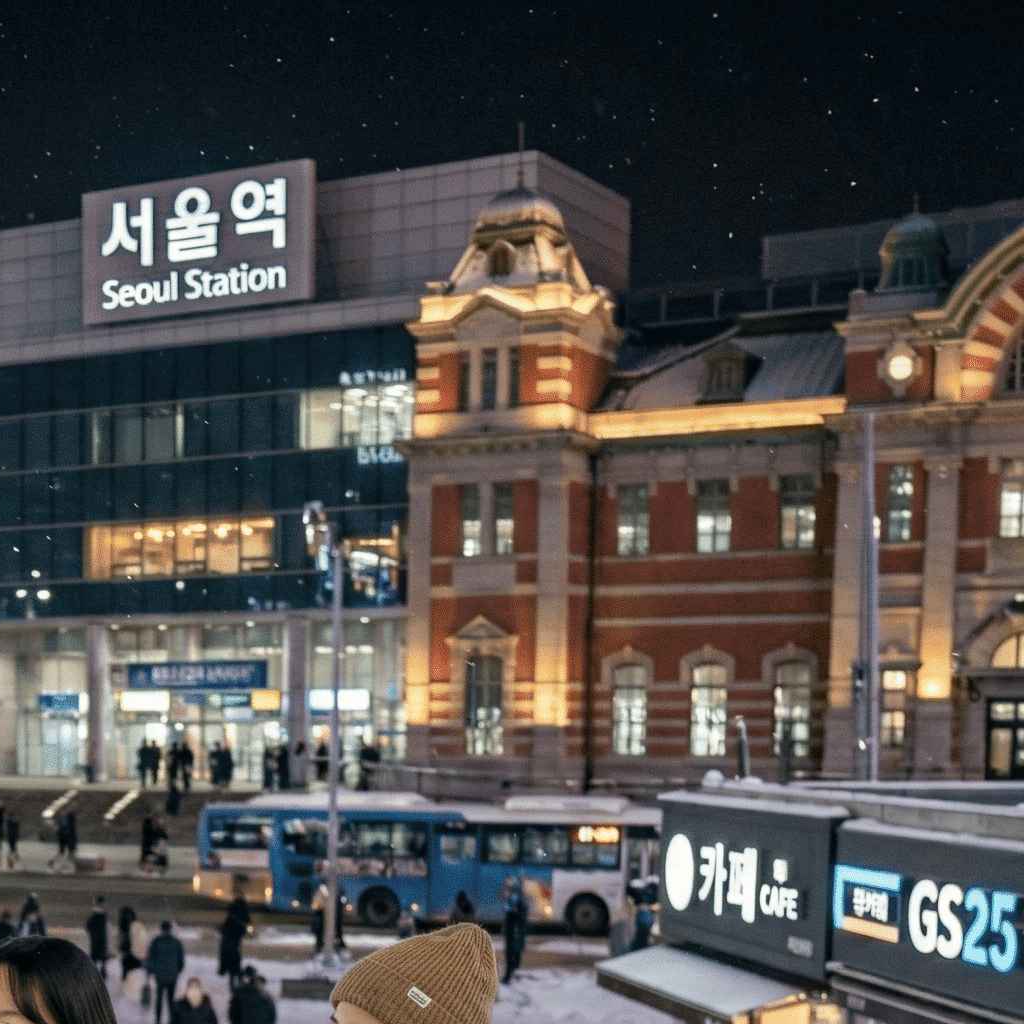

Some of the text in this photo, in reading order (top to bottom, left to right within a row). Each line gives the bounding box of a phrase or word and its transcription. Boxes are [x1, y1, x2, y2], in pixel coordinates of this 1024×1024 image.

[101, 177, 287, 267] 서울역
[101, 263, 287, 310] Seoul Station
[698, 841, 758, 924] 카페
[759, 883, 799, 921] CAFE
[908, 879, 1018, 973] GS25
